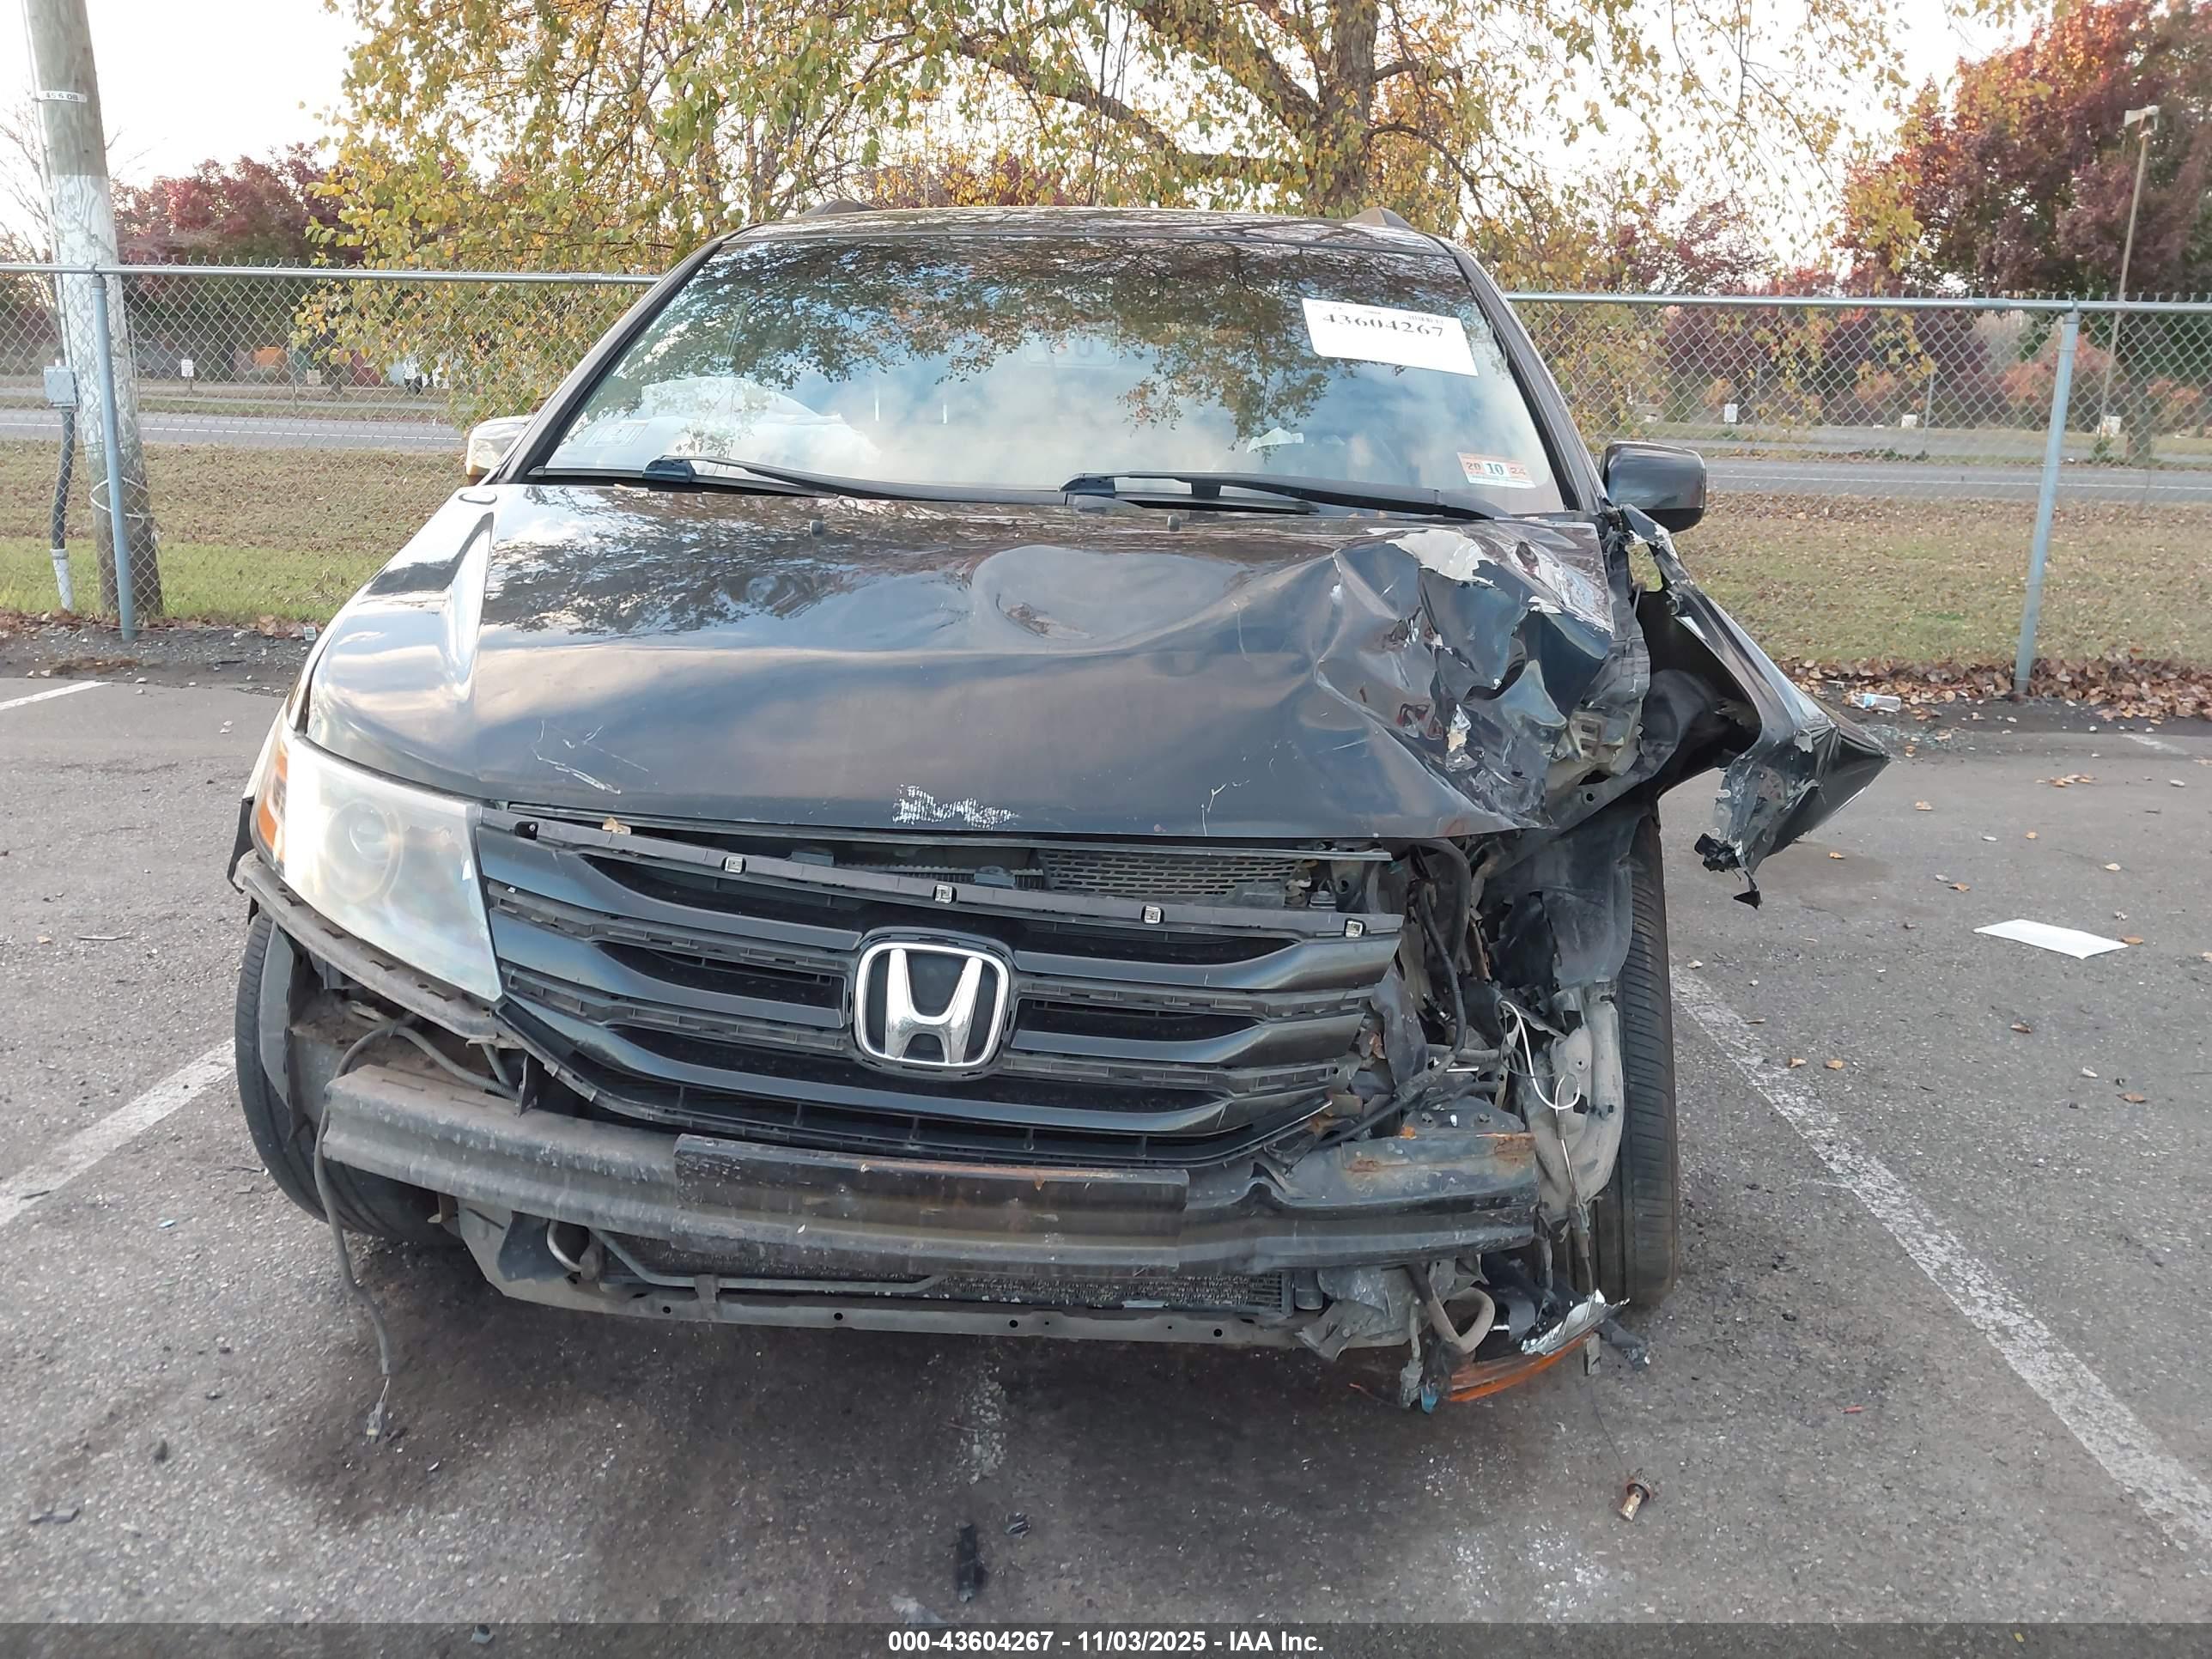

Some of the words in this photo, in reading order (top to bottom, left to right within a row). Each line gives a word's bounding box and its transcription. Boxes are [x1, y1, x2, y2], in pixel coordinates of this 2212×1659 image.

[1321, 313, 1443, 337] 43604267
[1466, 461, 1480, 471] 20
[1485, 463, 1504, 476] 10
